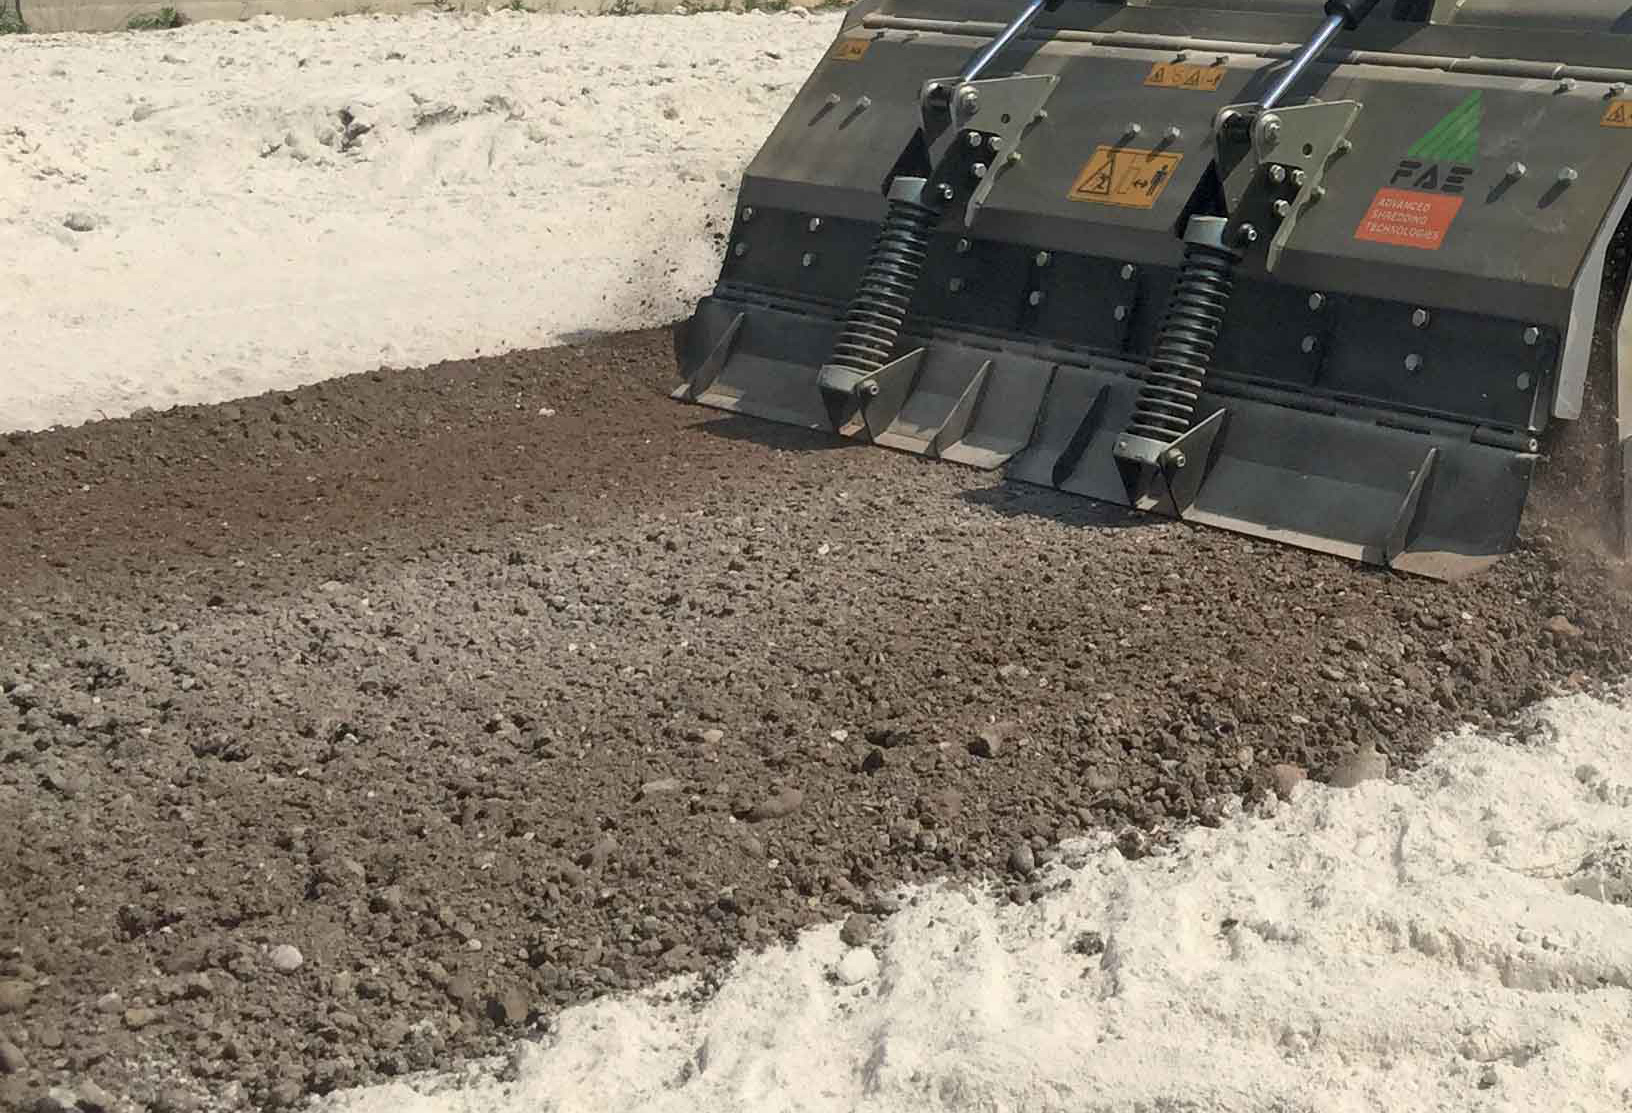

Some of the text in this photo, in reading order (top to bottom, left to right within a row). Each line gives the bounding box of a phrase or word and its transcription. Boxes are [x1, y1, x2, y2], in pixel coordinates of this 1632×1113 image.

[1390, 160, 1474, 193] FAE
[1377, 198, 1432, 212] ADVANCED
[1367, 221, 1441, 240] TECHNOLOGIES
